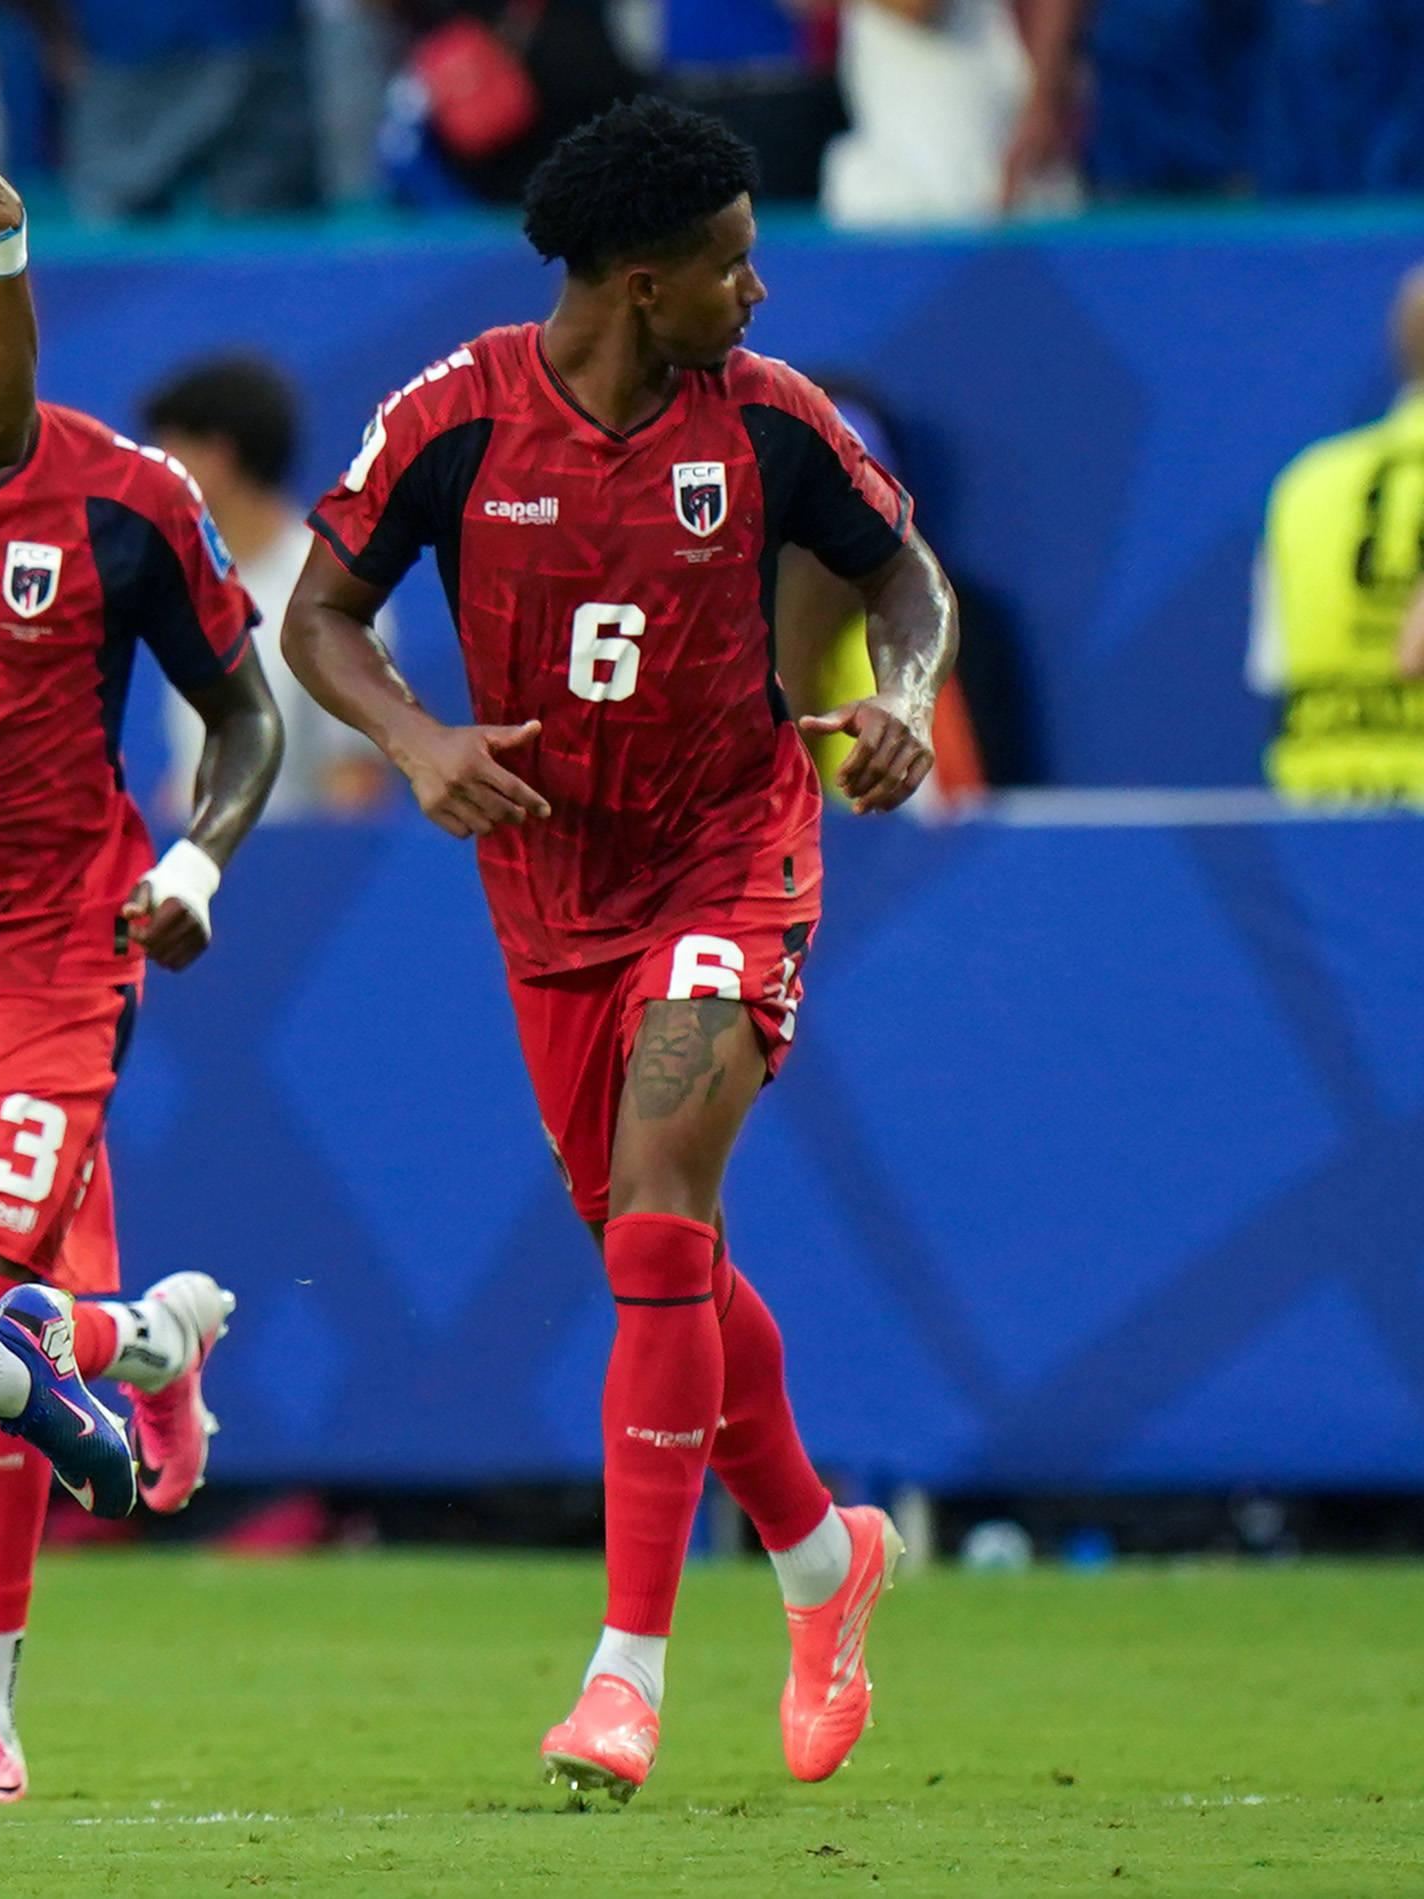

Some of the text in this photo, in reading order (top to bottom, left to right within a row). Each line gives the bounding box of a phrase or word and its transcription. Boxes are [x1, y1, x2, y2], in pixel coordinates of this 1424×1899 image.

[678, 465, 721, 479] FCF
[484, 496, 559, 522] capelli
[567, 602, 646, 702] 6
[667, 934, 745, 1000] 6
